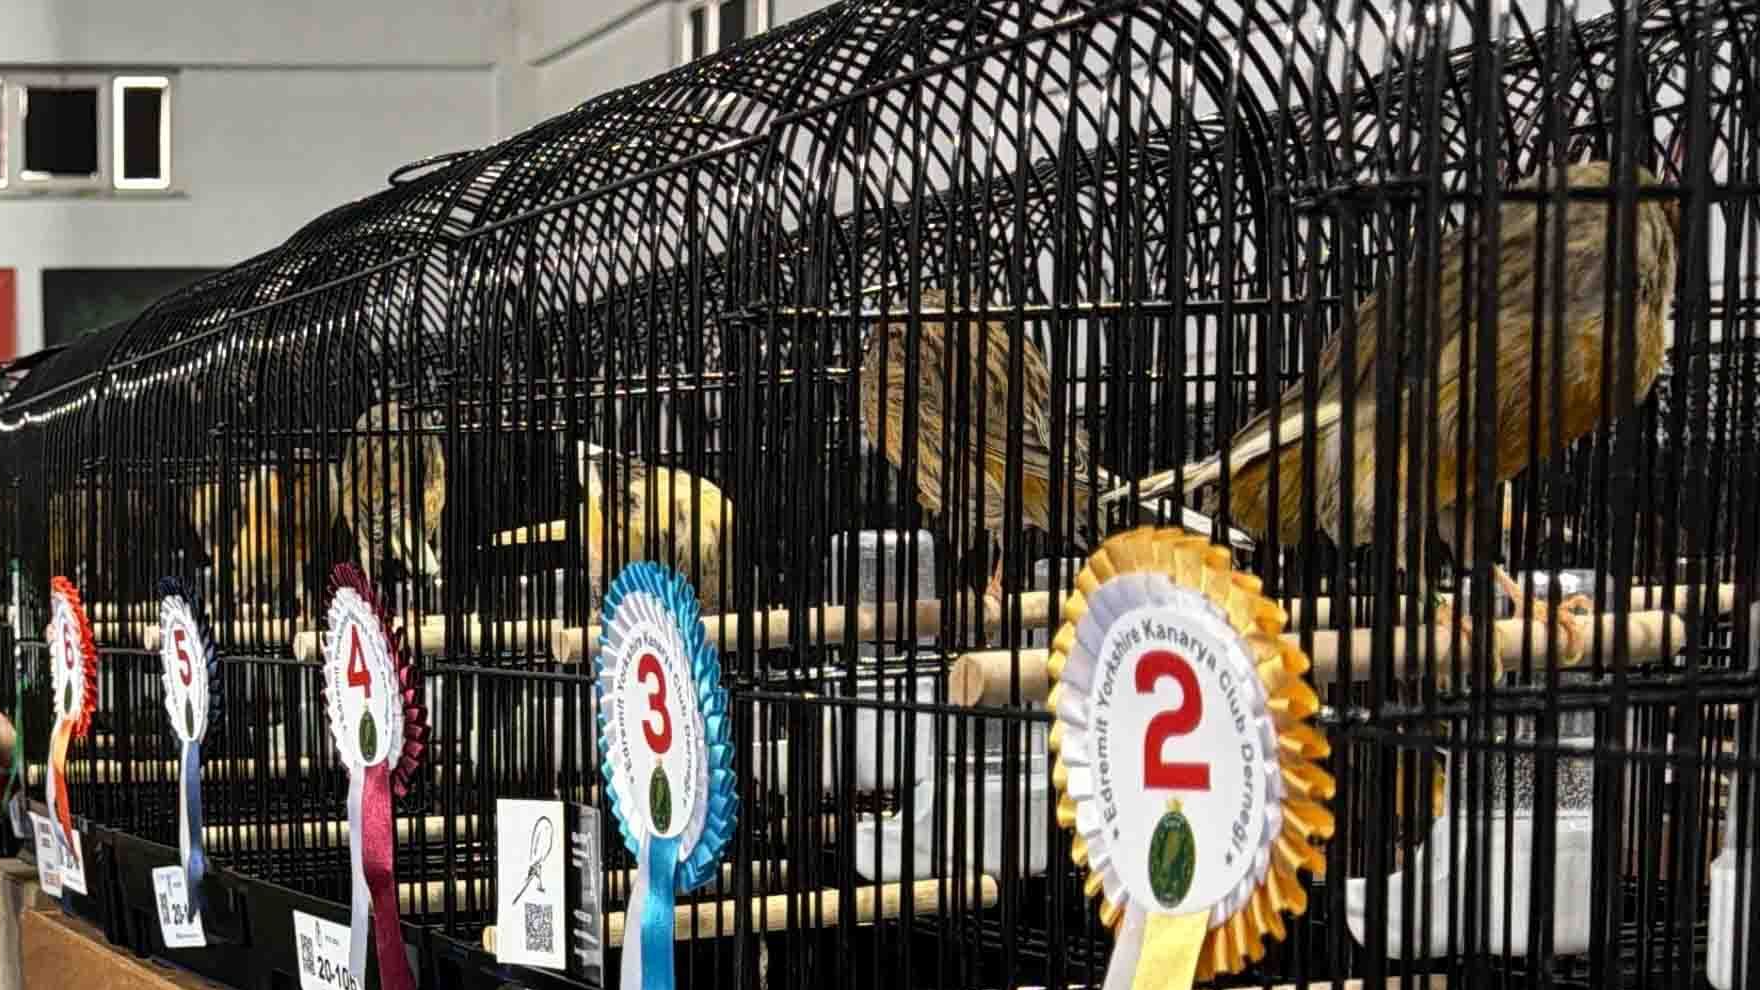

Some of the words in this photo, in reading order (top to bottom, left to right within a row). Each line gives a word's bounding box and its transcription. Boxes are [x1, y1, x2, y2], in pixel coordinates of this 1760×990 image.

[63, 624, 75, 670] 6
[174, 629, 193, 687] 5
[347, 623, 372, 699] 4
[1096, 626, 1140, 709] Yorkshire
[1141, 617, 1217, 672] Kanarya
[637, 653, 673, 755] 3
[1134, 648, 1212, 791] 2
[1218, 669, 1246, 734] Club
[1095, 716, 1117, 824] Edremit
